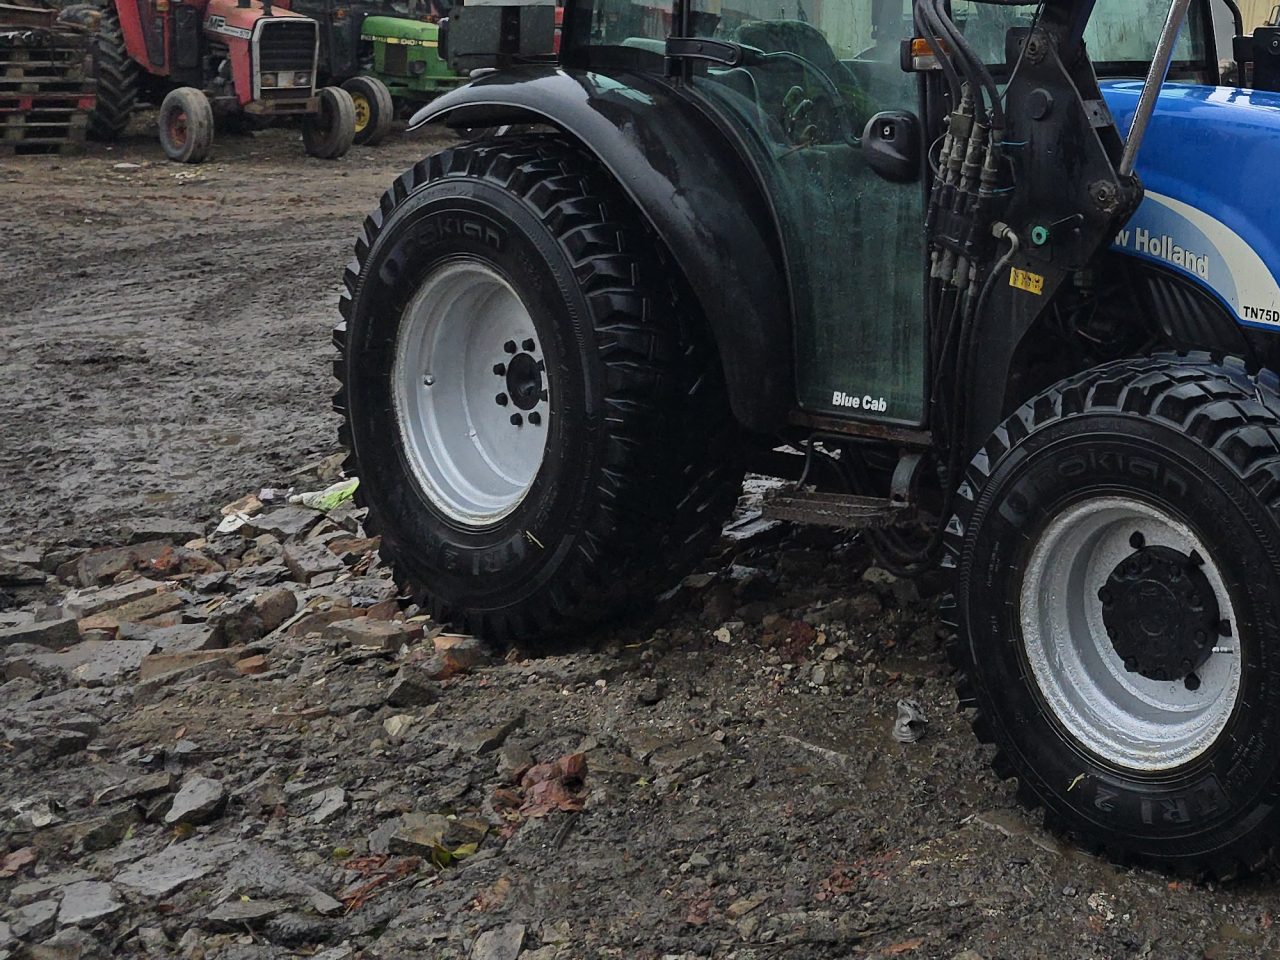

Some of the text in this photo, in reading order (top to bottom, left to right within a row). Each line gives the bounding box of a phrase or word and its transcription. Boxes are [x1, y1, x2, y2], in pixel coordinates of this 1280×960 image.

[1135, 227, 1209, 280] Holland
[832, 391, 887, 412] Blue Cab
